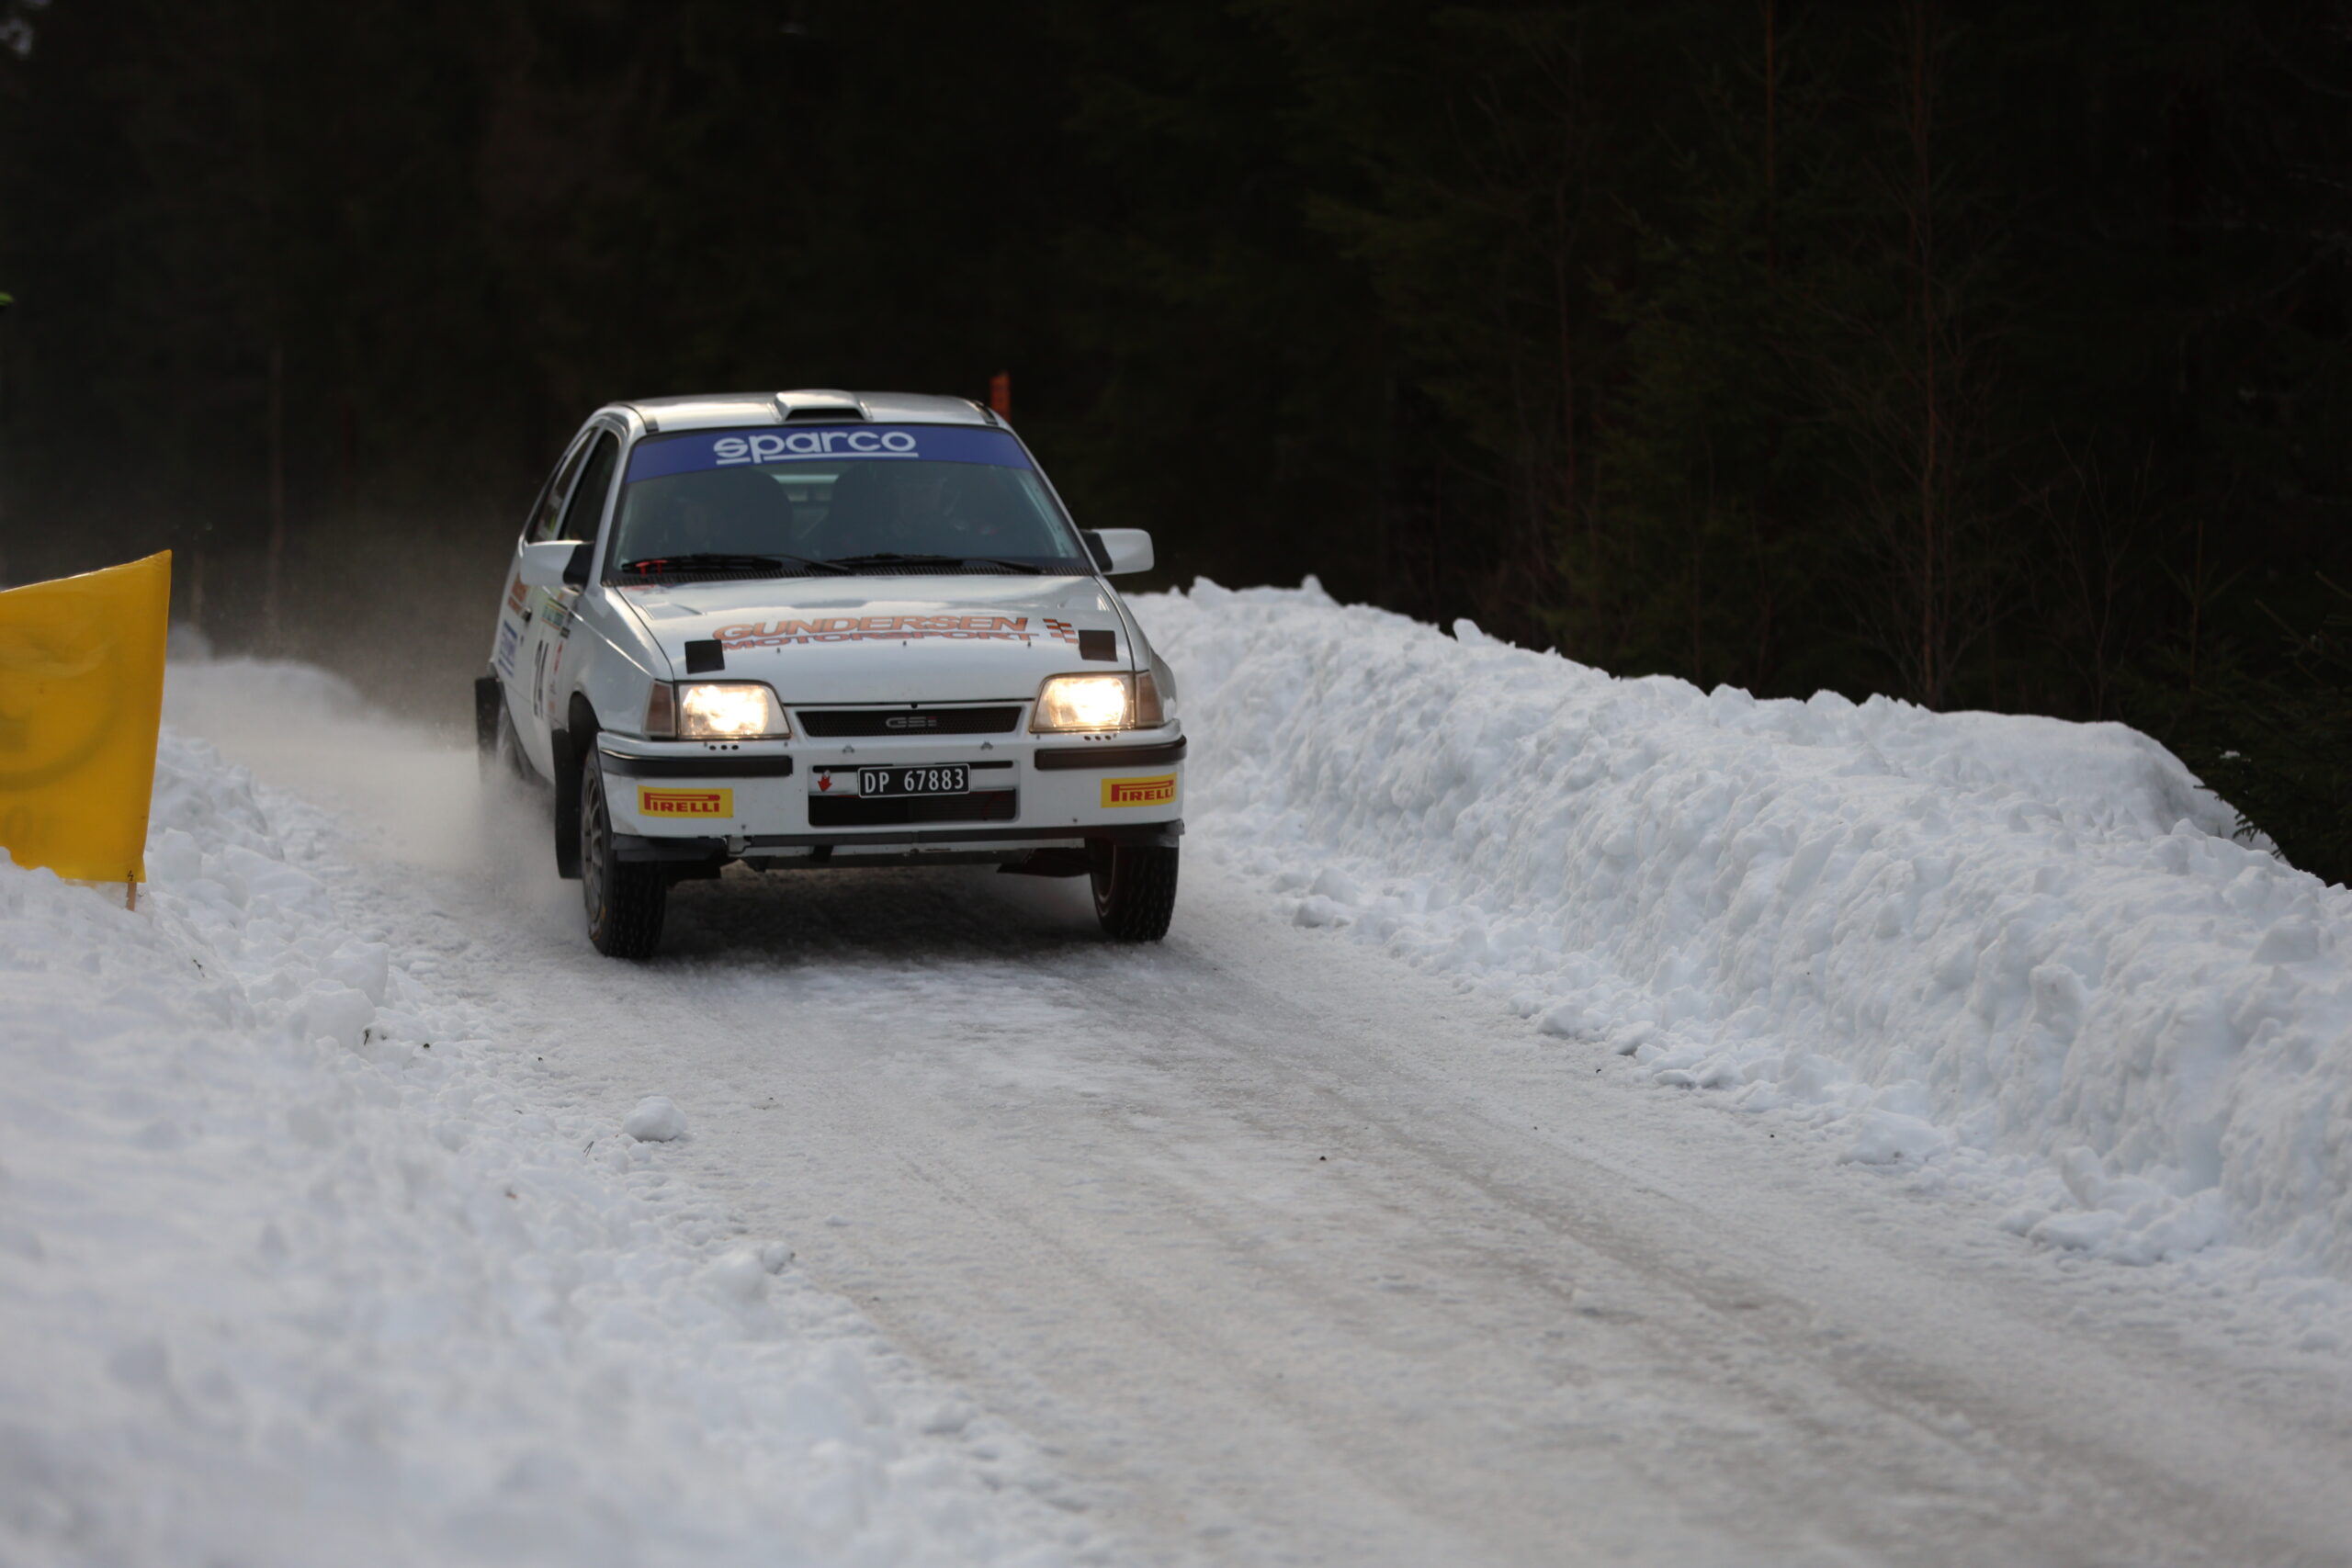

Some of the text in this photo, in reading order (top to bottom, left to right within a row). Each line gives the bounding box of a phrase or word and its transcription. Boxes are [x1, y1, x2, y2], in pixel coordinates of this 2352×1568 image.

[713, 431, 918, 464] sparco
[713, 615, 1028, 640] GUNDERSEN
[722, 631, 1039, 651] MOTORSPORT
[865, 769, 964, 793] DP 67883
[644, 792, 720, 813] PIRELLI
